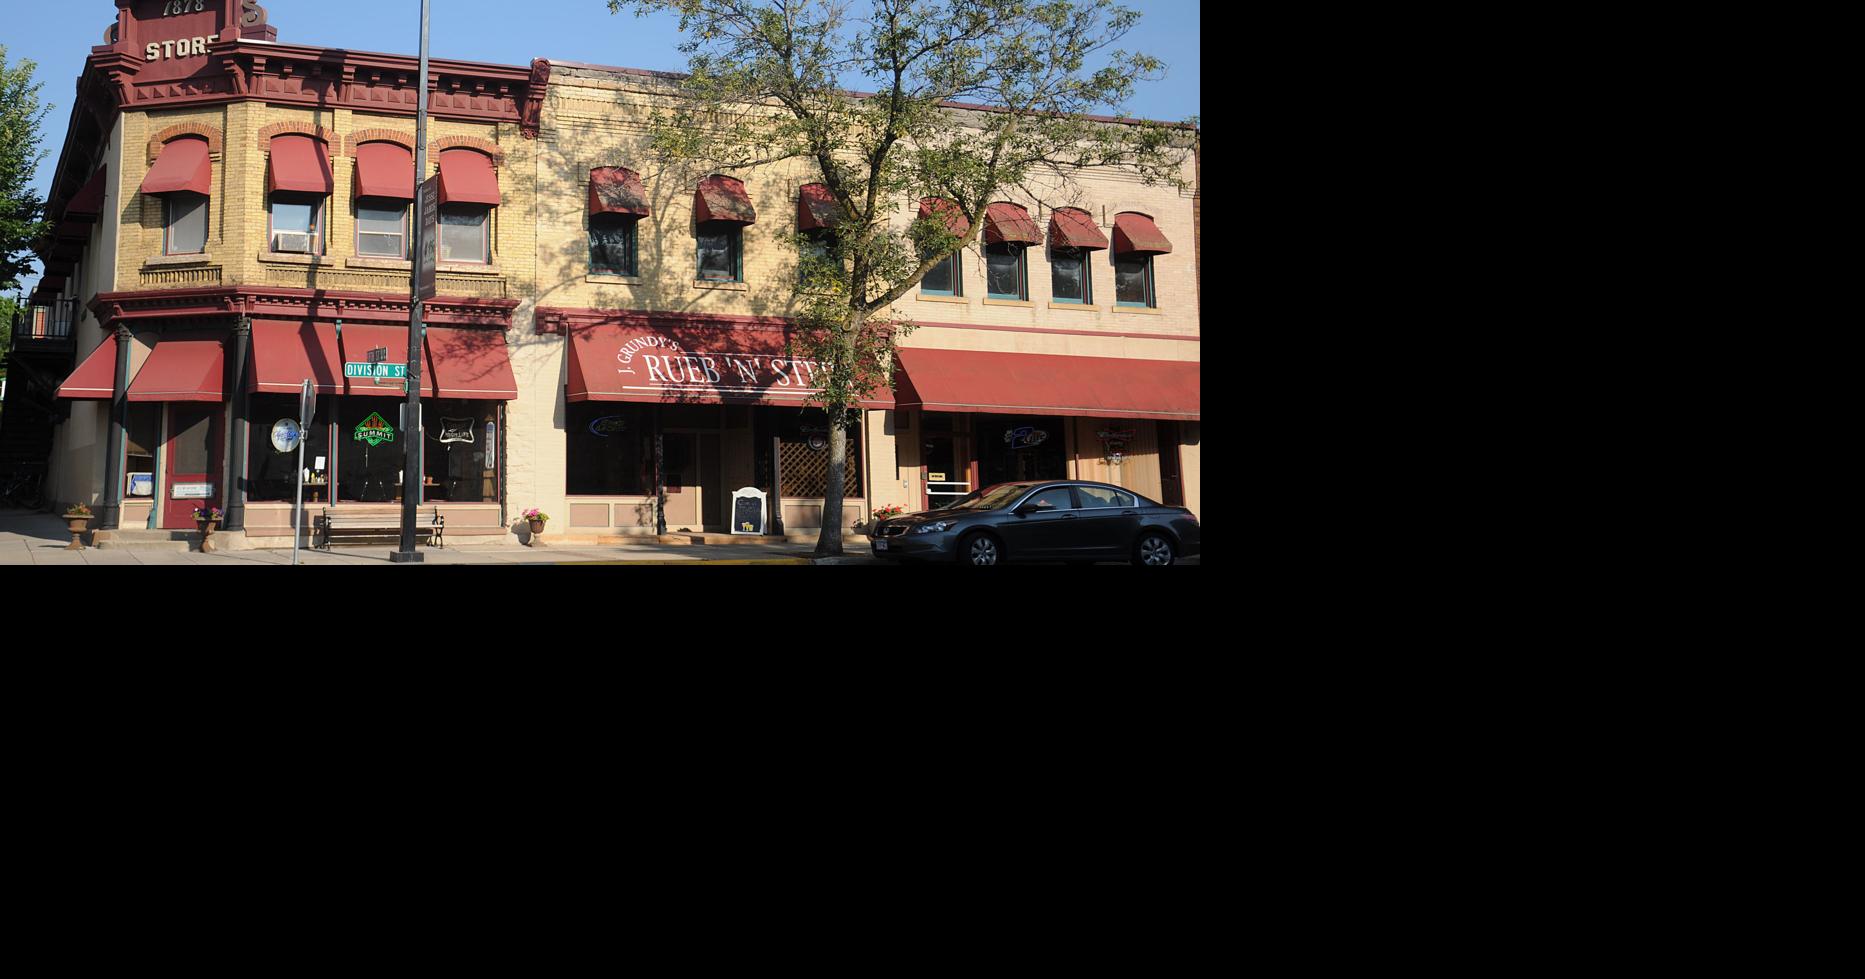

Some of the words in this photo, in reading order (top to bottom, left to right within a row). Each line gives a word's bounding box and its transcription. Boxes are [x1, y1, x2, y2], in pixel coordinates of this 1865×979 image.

[617, 336, 680, 364] GRUNDY'S
[347, 364, 389, 377] DIVISION
[394, 365, 405, 377] ST
[617, 366, 636, 375] J.
[642, 354, 721, 383] RUEB
[724, 357, 761, 384] 'N'
[357, 430, 391, 439] SUMMIT
